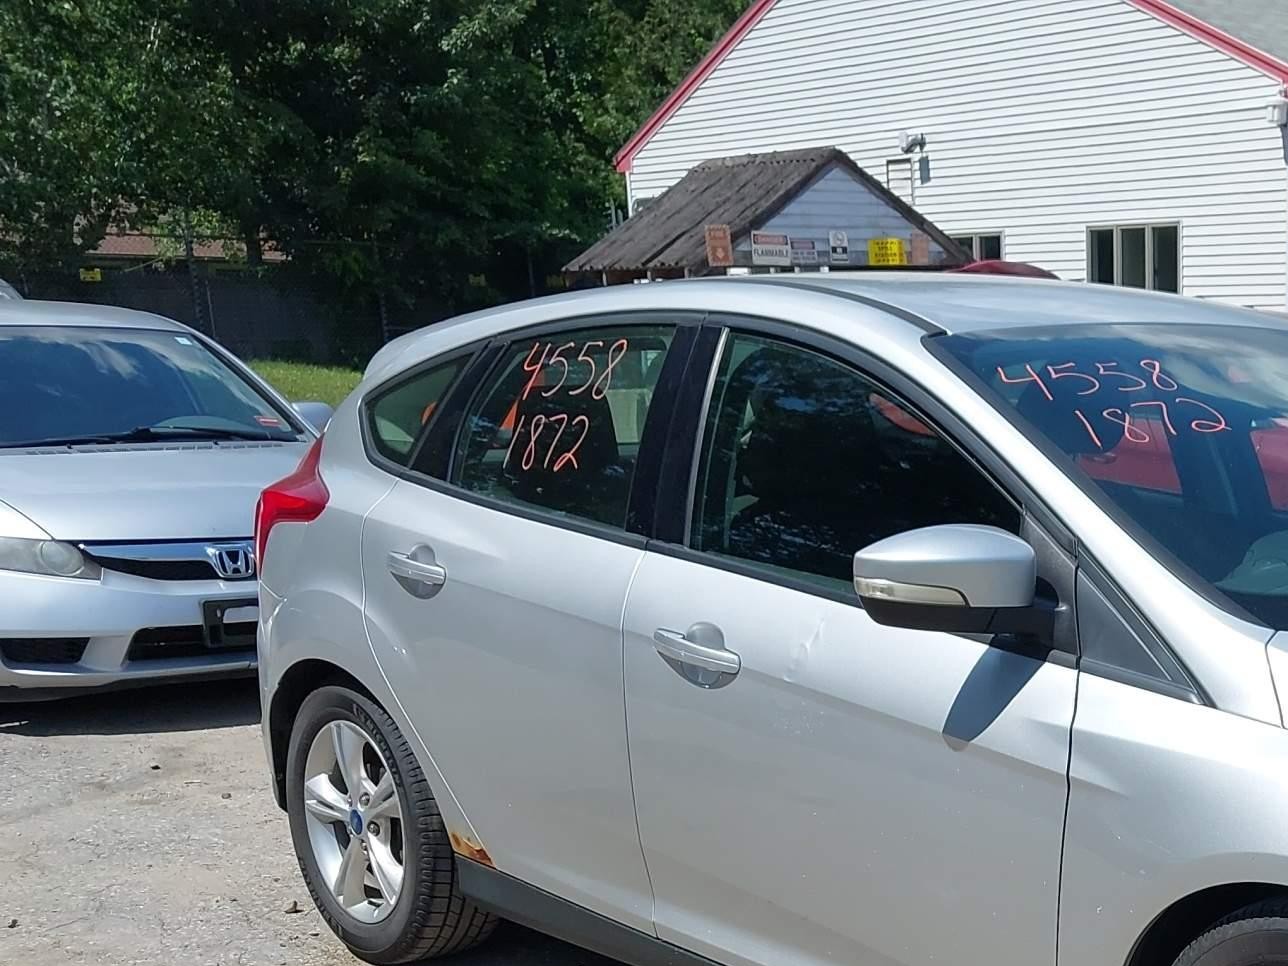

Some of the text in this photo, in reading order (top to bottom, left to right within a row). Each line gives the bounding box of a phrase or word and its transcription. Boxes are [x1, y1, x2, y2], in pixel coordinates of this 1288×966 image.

[523, 338, 628, 400] 4558
[996, 359, 1178, 401] 4558
[502, 413, 589, 471] 1872
[1074, 398, 1232, 449] 1872
